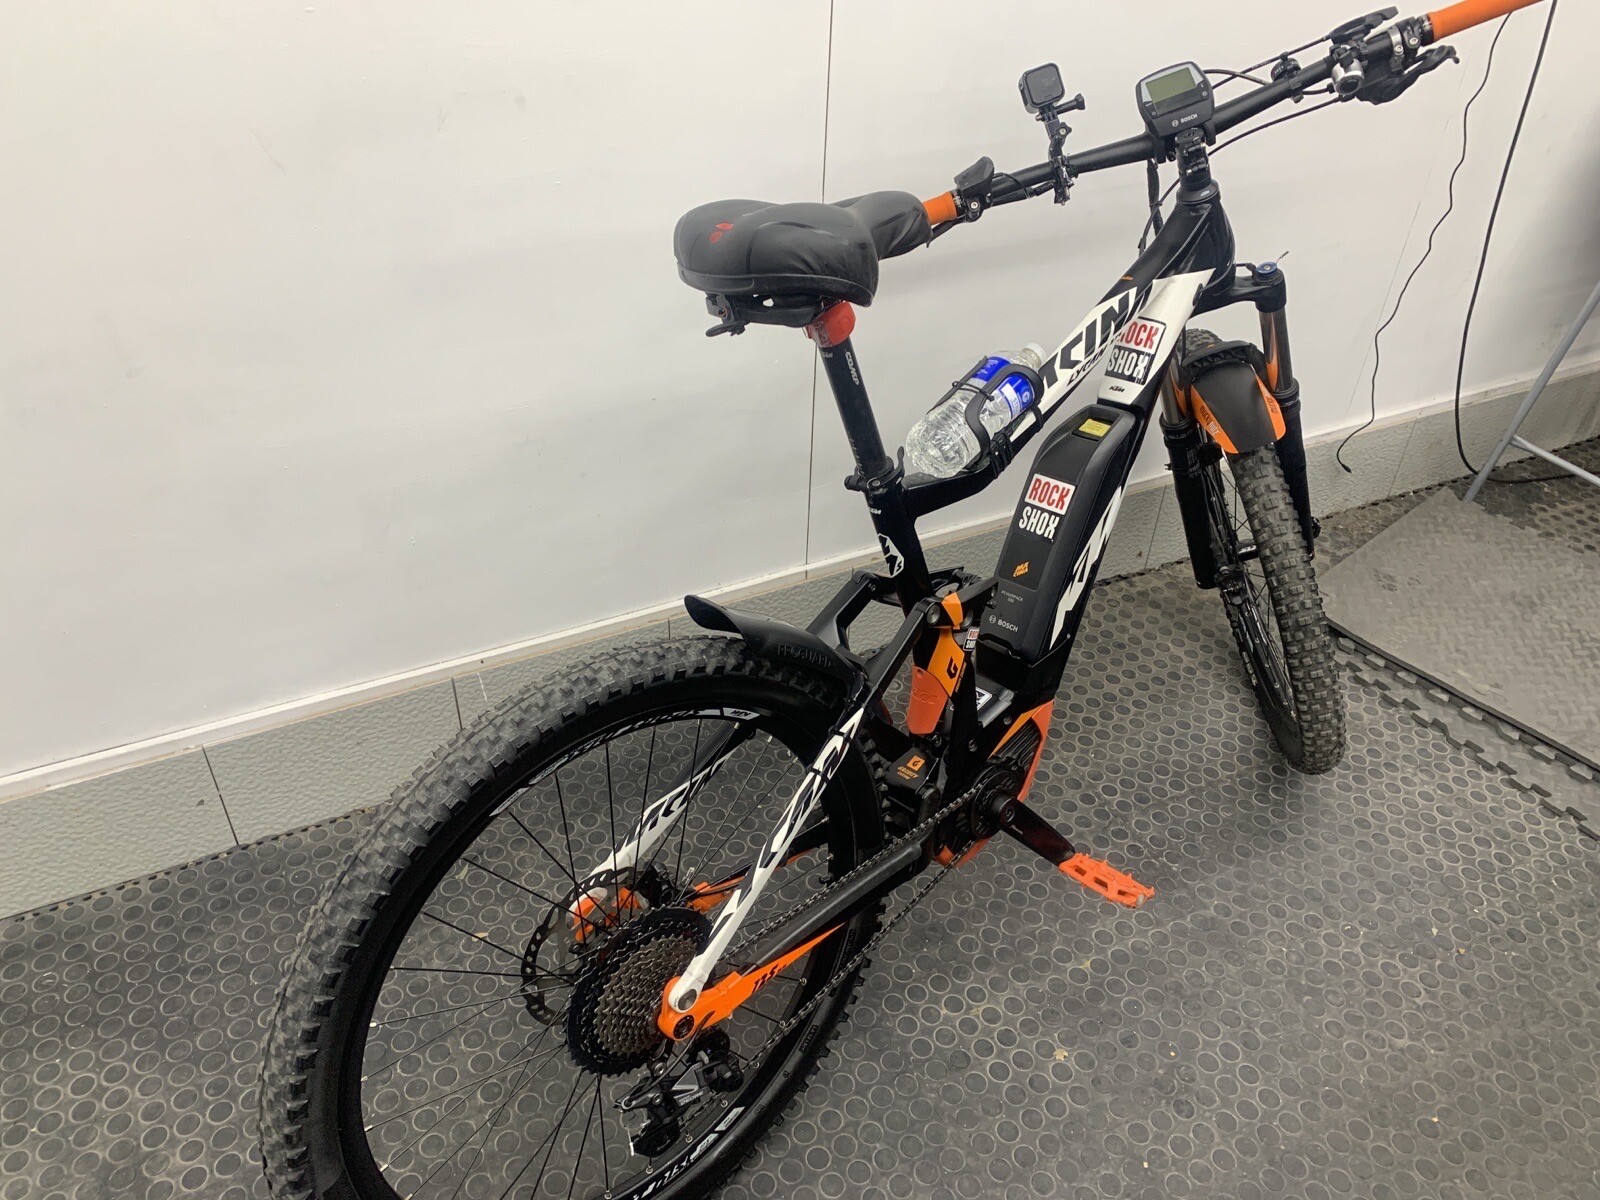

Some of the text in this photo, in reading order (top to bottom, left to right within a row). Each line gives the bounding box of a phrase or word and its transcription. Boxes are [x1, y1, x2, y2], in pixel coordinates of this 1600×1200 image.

[1180, 113, 1198, 124] BOSCH
[1108, 348, 1150, 379] SHOX
[1028, 478, 1071, 511] ROCK
[1018, 505, 1060, 540] SHOX
[997, 619, 1019, 633] BOSCH
